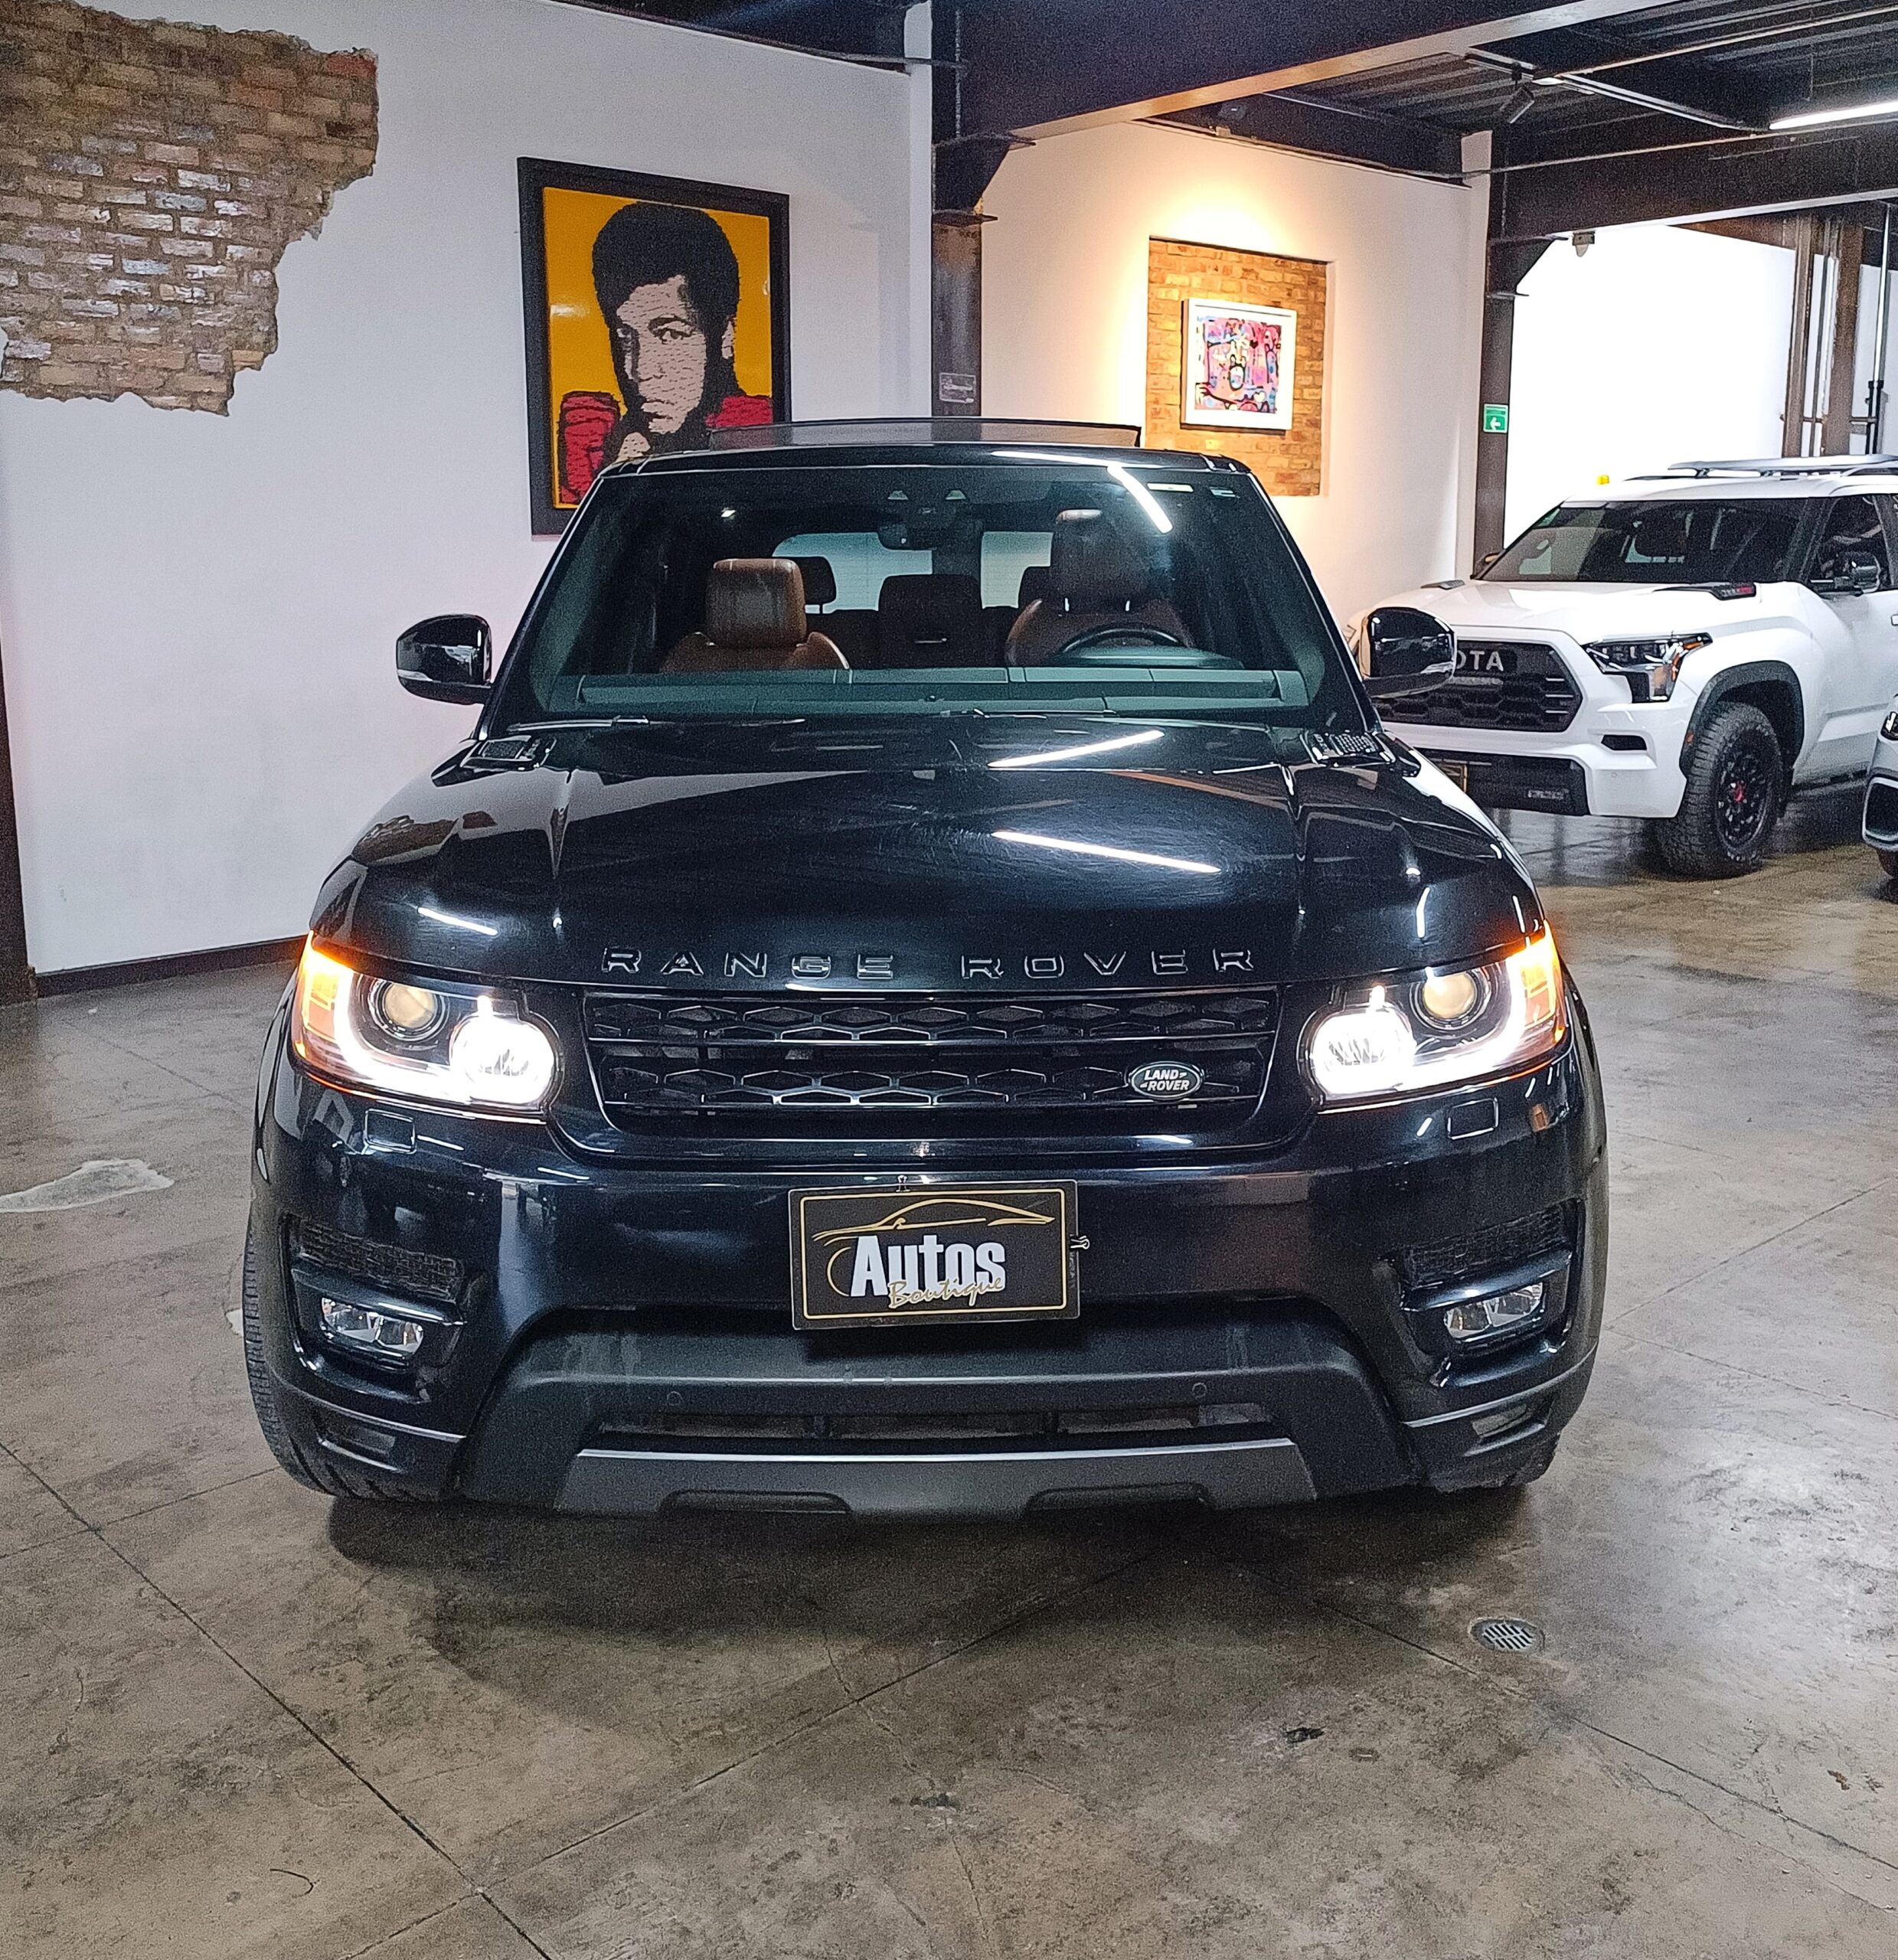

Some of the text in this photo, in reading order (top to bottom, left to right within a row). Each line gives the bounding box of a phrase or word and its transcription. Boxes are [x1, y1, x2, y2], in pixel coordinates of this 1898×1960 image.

[602, 948, 1254, 979] RANGE ROVER
[1144, 1070, 1179, 1080] LAND
[1147, 1080, 1191, 1091] ROVER
[850, 1235, 1006, 1297] Autos
[888, 1276, 1003, 1308] Boutique
